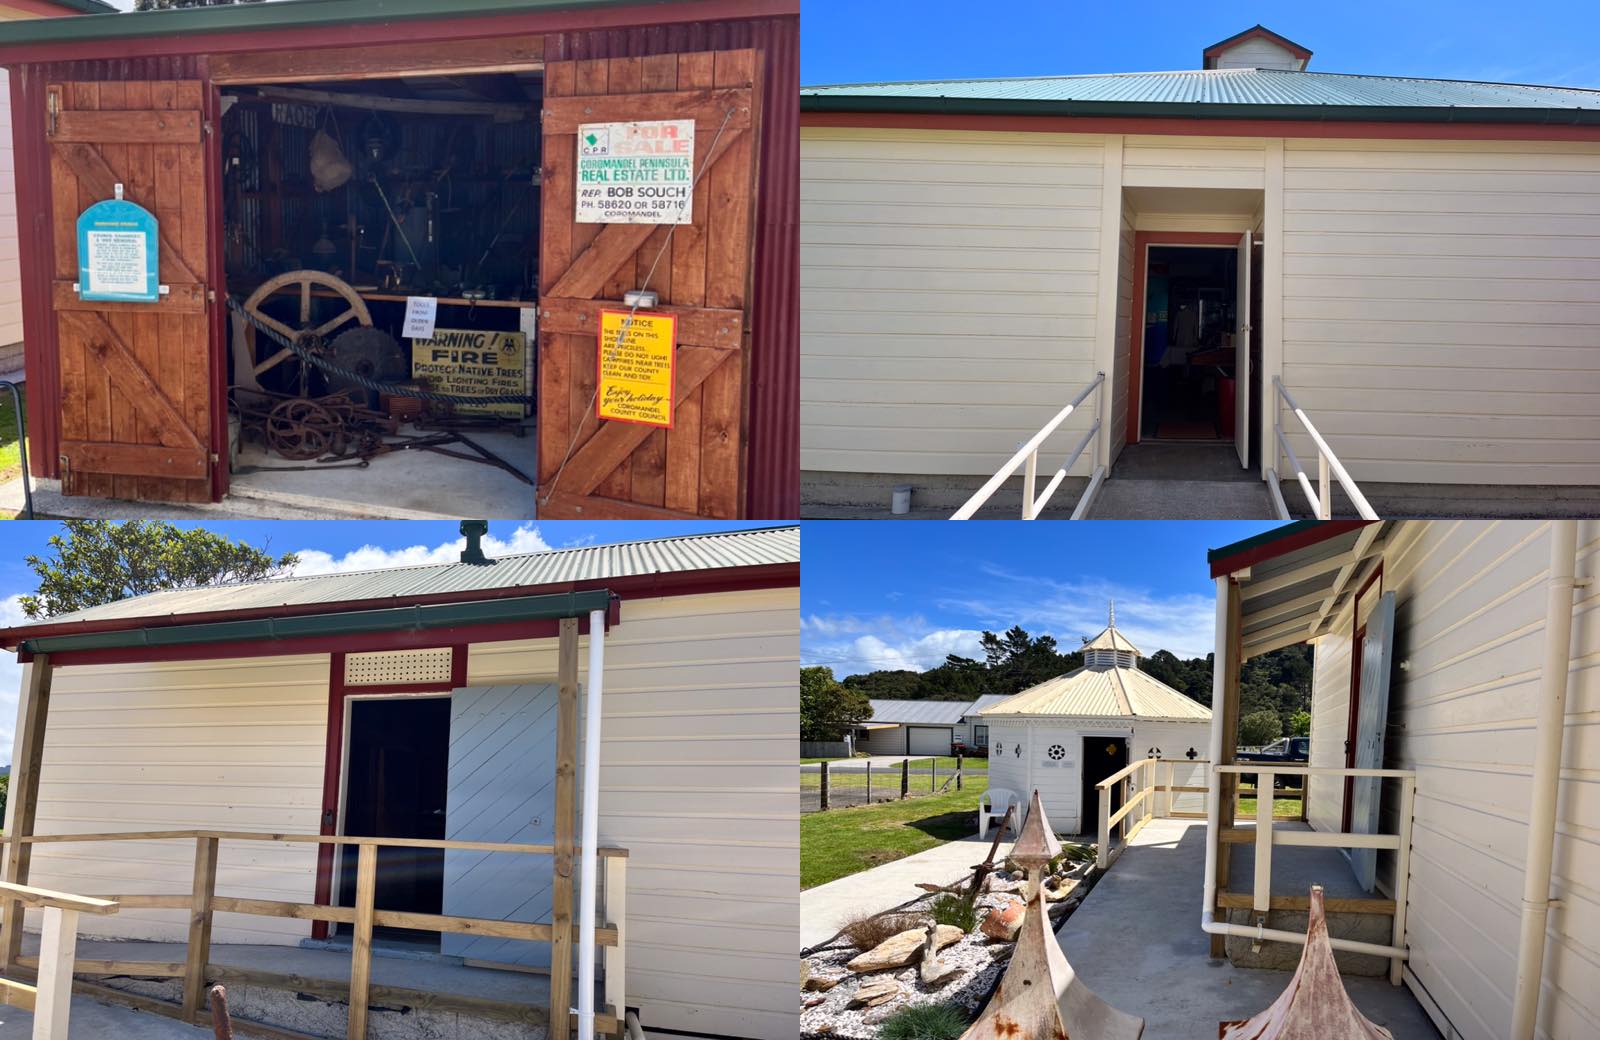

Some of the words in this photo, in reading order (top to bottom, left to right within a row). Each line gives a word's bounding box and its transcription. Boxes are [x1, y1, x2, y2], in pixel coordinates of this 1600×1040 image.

[626, 126, 678, 139] FOR
[614, 140, 689, 154] SALE
[580, 159, 637, 169] COROMANDEL
[639, 158, 690, 168] PENINSULA
[581, 170, 609, 181] REAL
[613, 170, 658, 181] ESTATE
[664, 169, 690, 181] LTD.
[607, 187, 634, 198] BOB
[637, 187, 686, 198] SOUCH
[597, 200, 632, 209] 58620
[634, 201, 648, 209] OR
[651, 200, 686, 210] 58716
[431, 350, 498, 364] FIRE
[414, 363, 456, 374] PROTECT
[458, 365, 494, 376] NATIVE
[496, 367, 523, 378] TREES
[446, 375, 488, 386] LIGHTING
[492, 378, 519, 387] FIRES
[450, 385, 477, 394] TREES
[617, 403, 661, 414] COROMANDEL
[610, 408, 636, 417] COUNTY
[638, 412, 667, 422] COUNCIL
